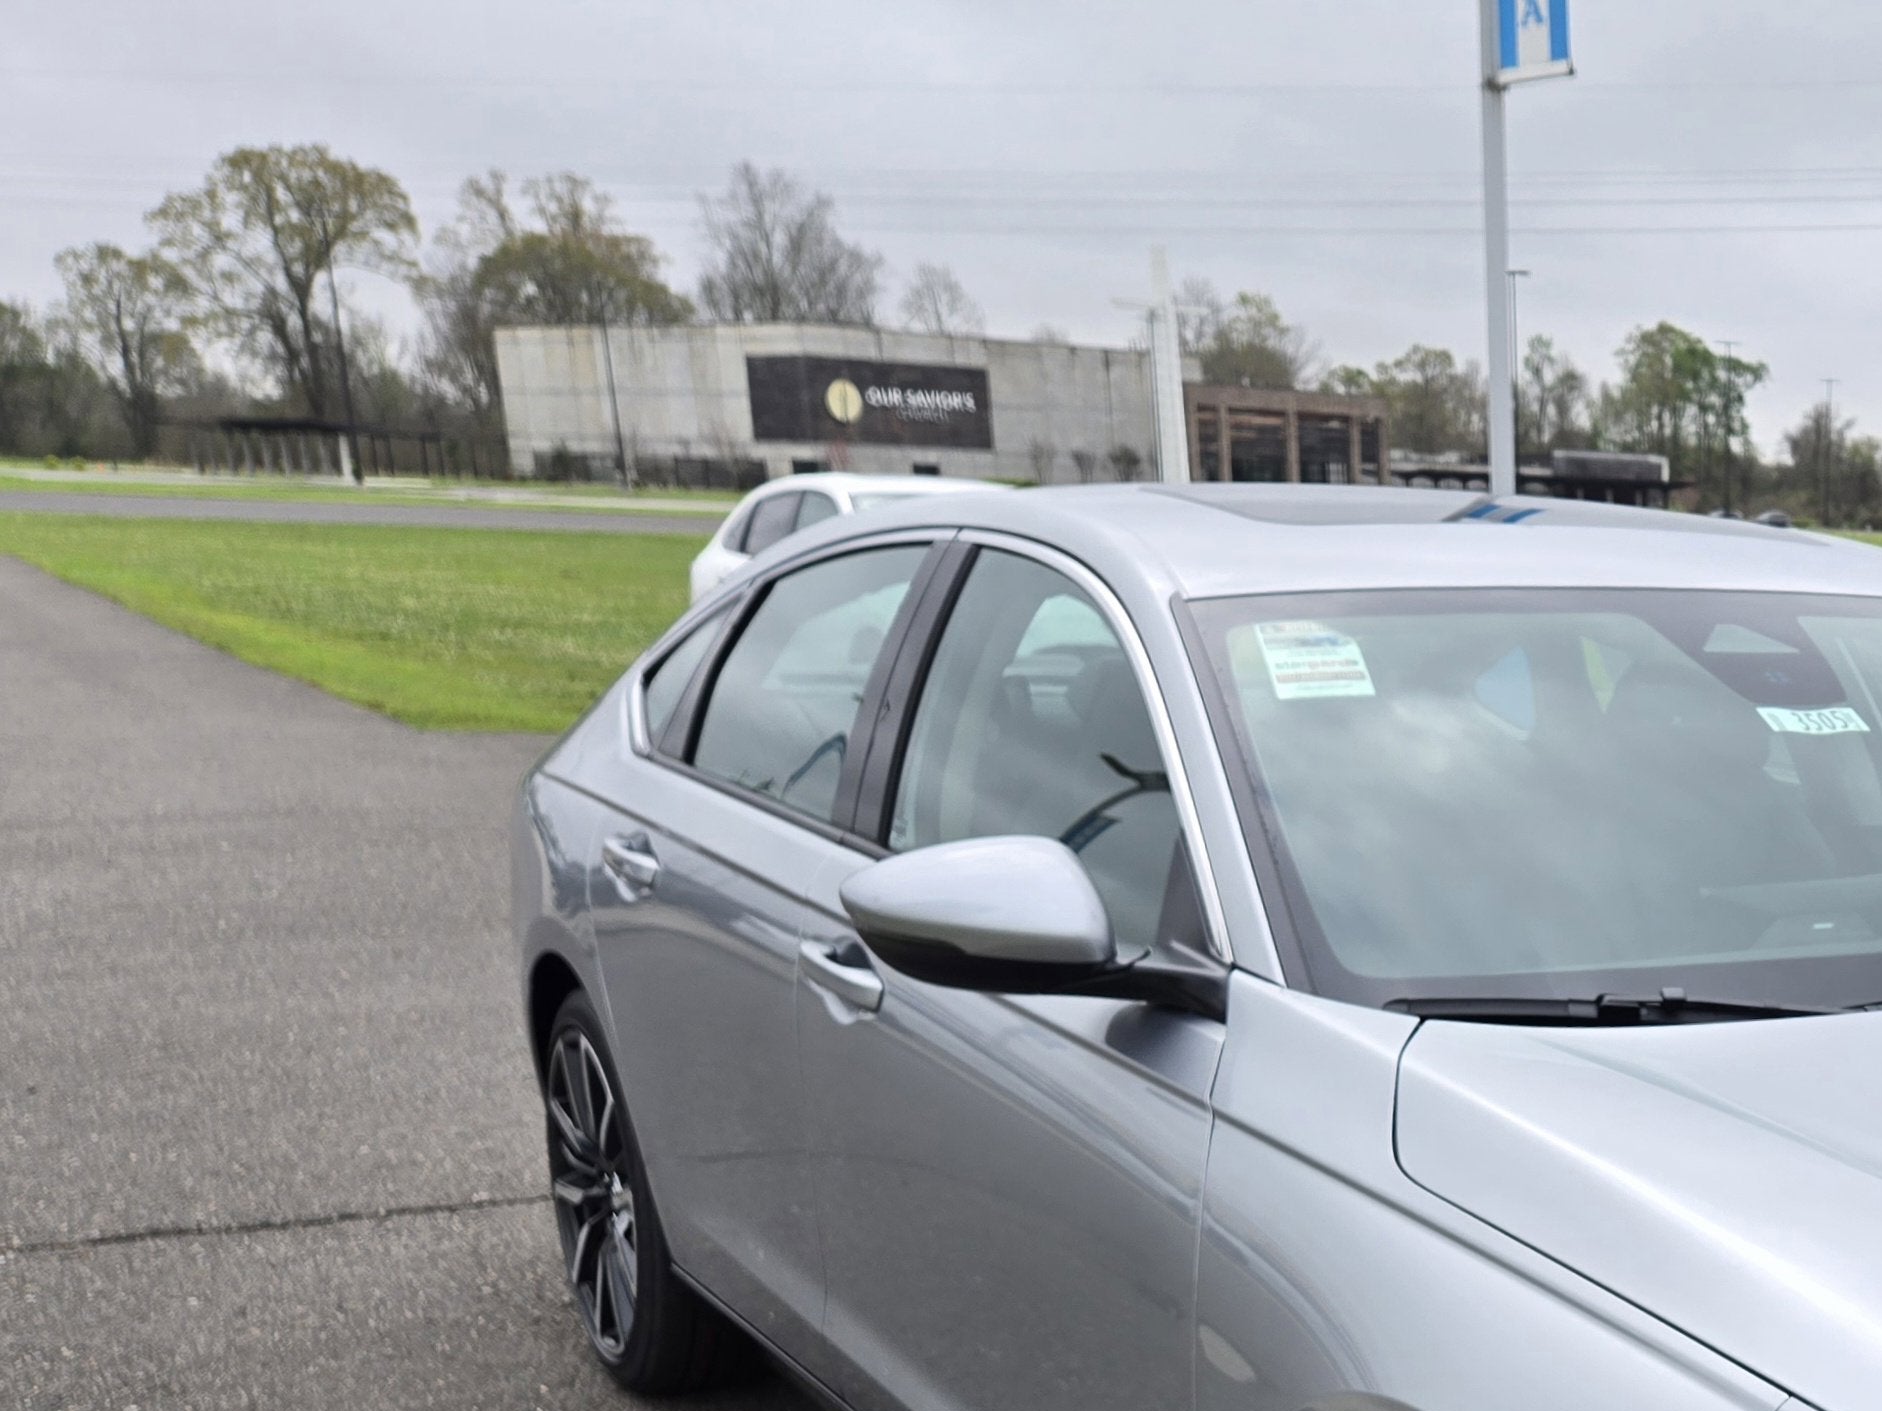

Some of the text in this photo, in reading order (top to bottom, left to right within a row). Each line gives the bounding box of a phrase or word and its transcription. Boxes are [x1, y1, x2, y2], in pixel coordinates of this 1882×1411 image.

[864, 384, 977, 414] OUR SAVIOR'S
[1789, 710, 1849, 732] 3505
